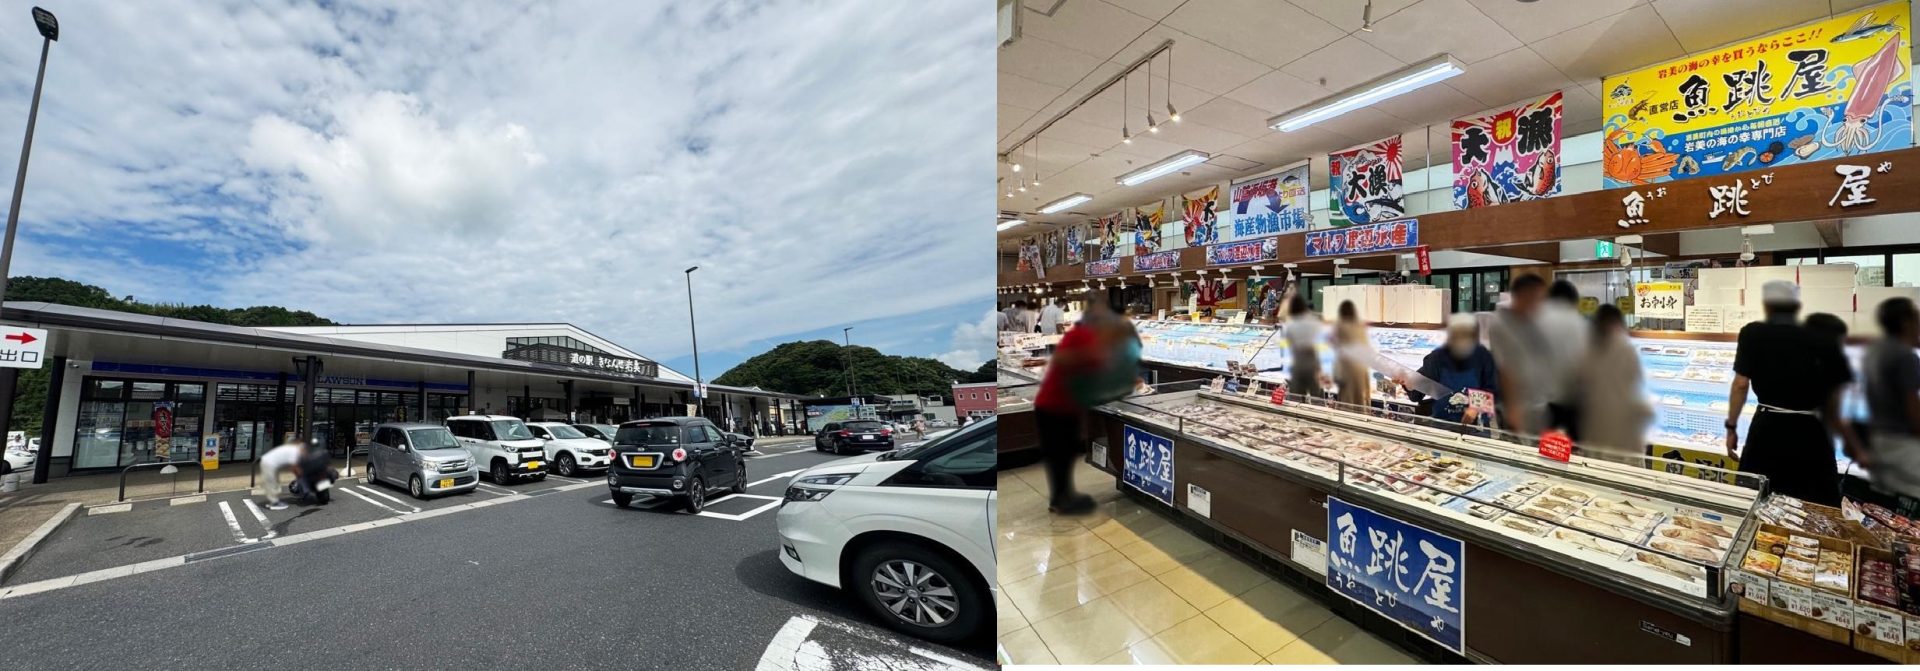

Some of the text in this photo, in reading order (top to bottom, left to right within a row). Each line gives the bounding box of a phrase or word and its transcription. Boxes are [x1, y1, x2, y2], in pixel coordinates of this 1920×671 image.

[1657, 28, 1822, 79] 岩美の海の幸を買うならここ!!
[1673, 50, 1835, 121] 魚跳屋
[1649, 100, 1679, 116] 直営店
[1495, 118, 1513, 141] 祝
[1685, 125, 1787, 152] 岩美の海の幸専門店
[1348, 164, 1389, 200] 大漁
[1234, 207, 1306, 237] 海産物漁市場
[1640, 295, 1677, 309] お刺身
[0, 349, 39, 363] 出口
[570, 352, 594, 366] 道の駅
[316, 375, 365, 386] LAWSON
[1126, 433, 1173, 484] 魚跳屋
[1330, 512, 1459, 613] 魚跳屋
